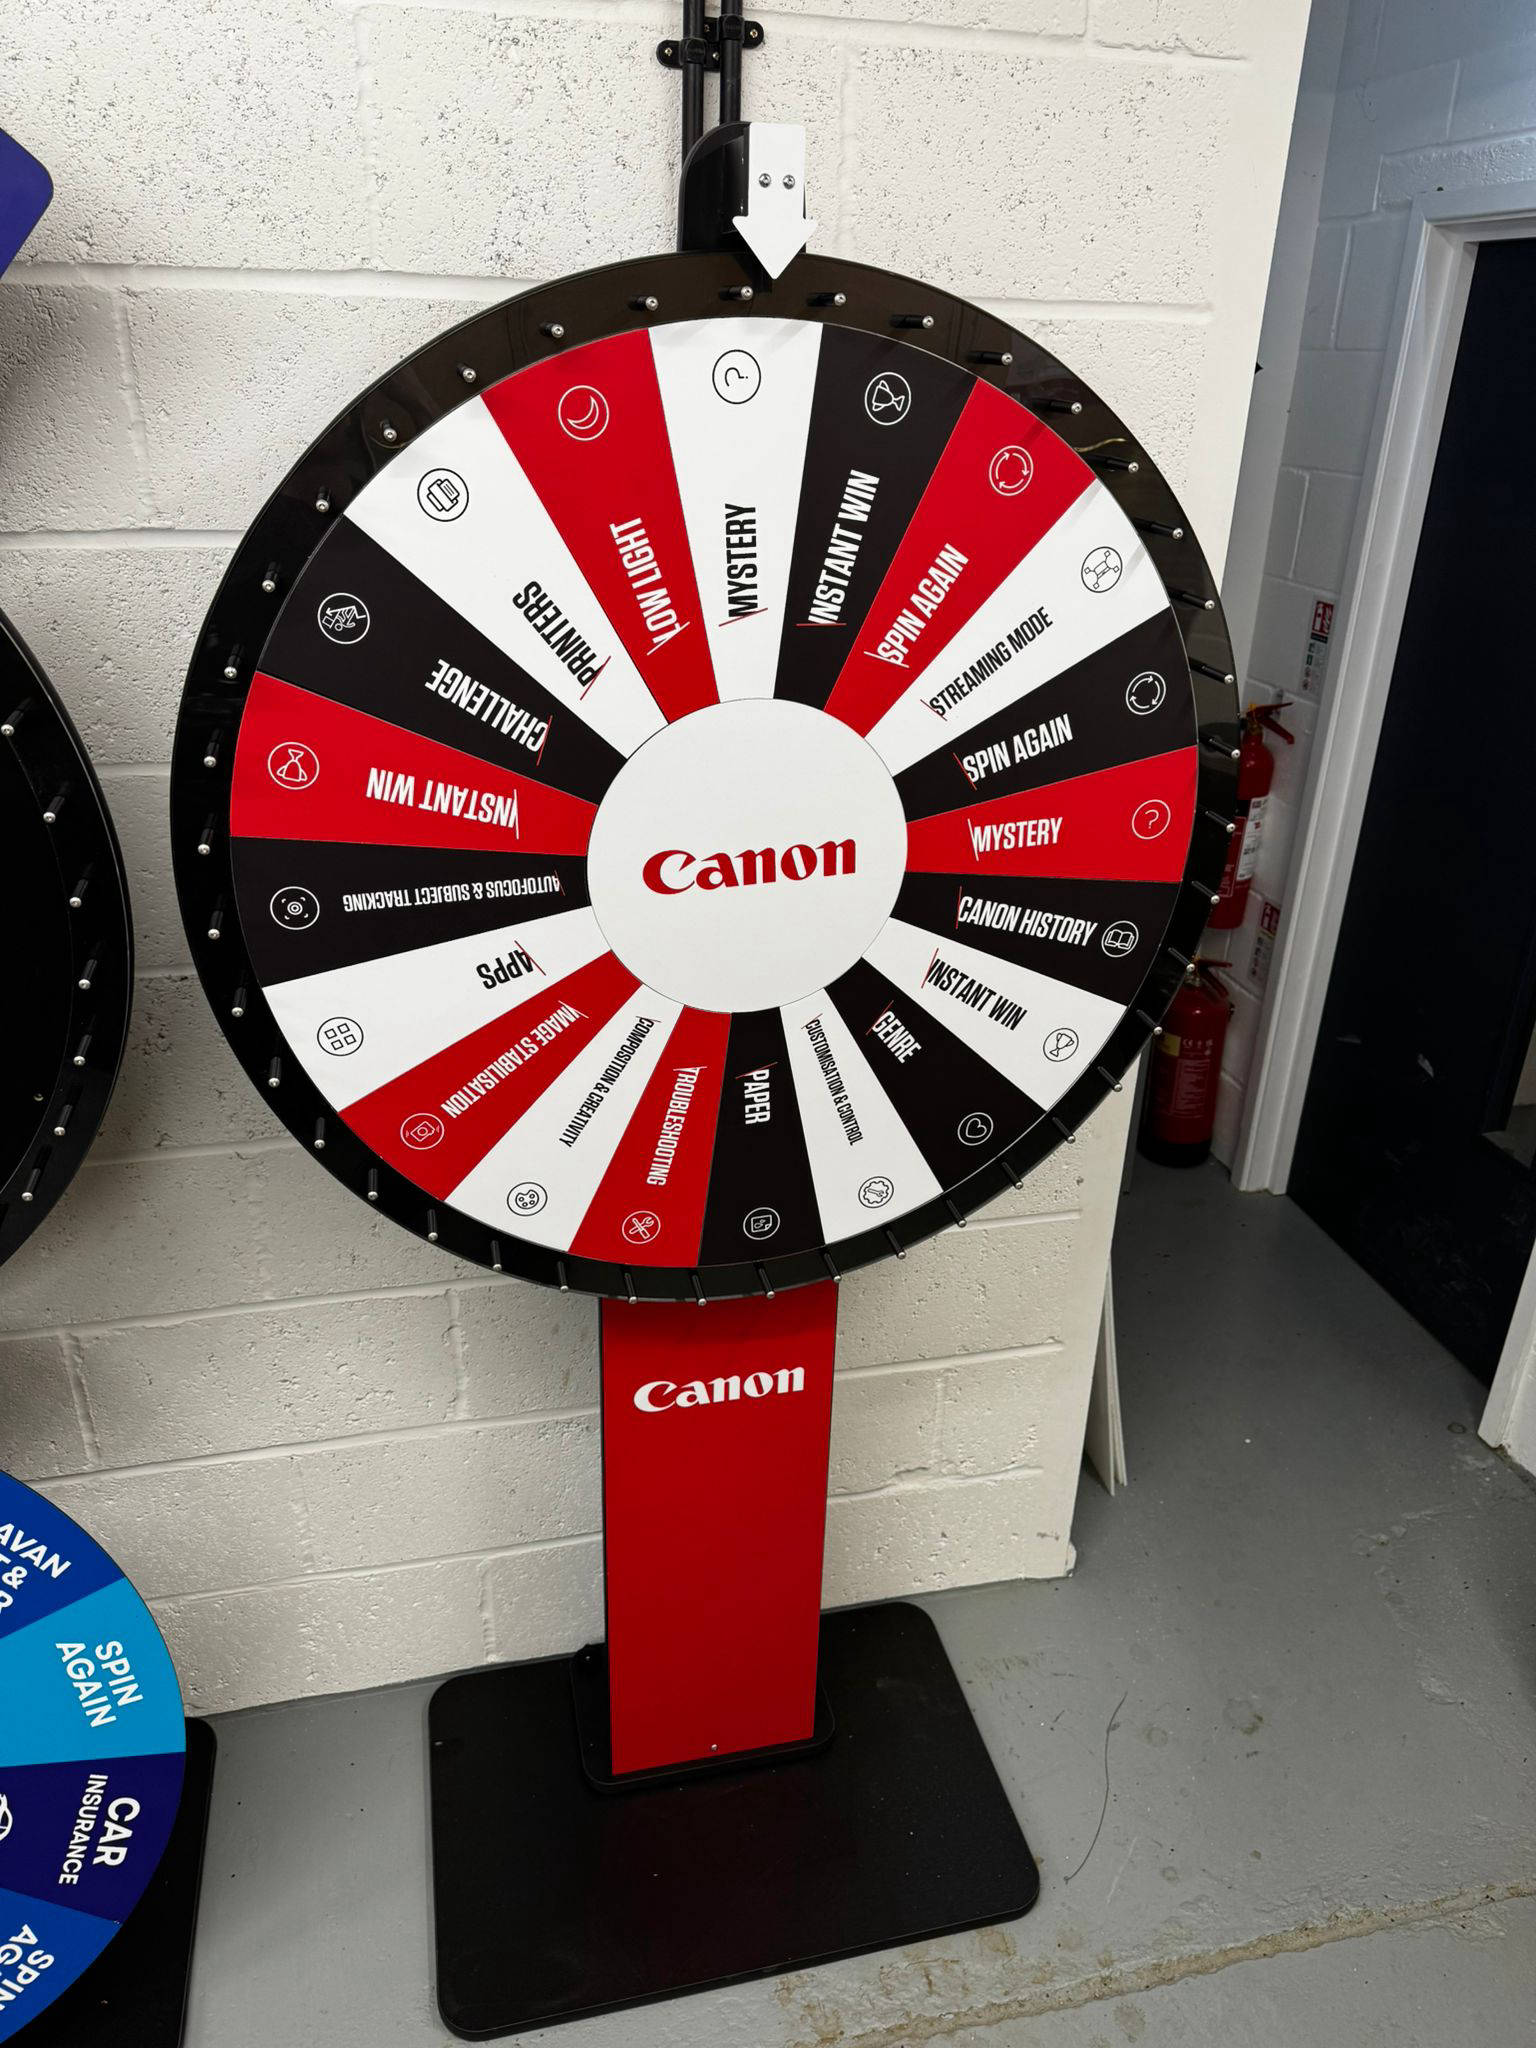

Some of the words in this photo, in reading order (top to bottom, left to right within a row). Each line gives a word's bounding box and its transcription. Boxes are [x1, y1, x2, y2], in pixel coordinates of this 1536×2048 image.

[609, 517, 662, 590] LIGHT
[725, 503, 758, 618] MYSTERY
[807, 522, 863, 625] INSTANT
[837, 469, 880, 522] WIN
[636, 587, 682, 644] LOW
[877, 608, 927, 667] SPIN
[910, 543, 969, 619] AGAIN
[512, 581, 606, 687] PRINTERS
[929, 641, 1012, 717] STREAMING
[1006, 606, 1053, 653] MODE
[424, 658, 549, 752] CHALLENGE
[962, 740, 1012, 783] SPIN
[1012, 713, 1074, 764] AGAIN
[366, 767, 415, 807] WIN
[418, 779, 518, 829] INSTANT
[973, 816, 1063, 853] MYSTERY
[414, 883, 470, 906] SUBJECT
[471, 882, 484, 900] &
[486, 875, 561, 899] AUTOFOCUS
[642, 839, 856, 895] Canon
[342, 889, 412, 913] TRACKING
[957, 896, 1022, 932] CANON
[1018, 908, 1099, 947] HISTORY
[476, 950, 535, 990] APPS
[927, 958, 997, 1012] INSTANT
[988, 995, 1028, 1031] WIN
[530, 1004, 581, 1046] IMAGE
[600, 1017, 655, 1086] COMPOSITION
[872, 1010, 922, 1064] GENRE
[440, 1036, 539, 1119] STABILISATION
[805, 1018, 846, 1097] CUSTOMISATION
[593, 1082, 610, 1093] &
[744, 1069, 770, 1125] PAPER
[833, 1094, 849, 1106] &
[559, 1092, 604, 1148] CREATIVITY
[646, 1067, 700, 1186] TROUBLESHOOTING
[837, 1102, 864, 1146] CONTROL
[633, 1366, 805, 1413] Canon
[55, 1642, 117, 1728] AGAIN
[95, 1640, 144, 1707] SPIN
[58, 1773, 109, 1885] INSURANCE
[92, 1796, 141, 1866] CAR
